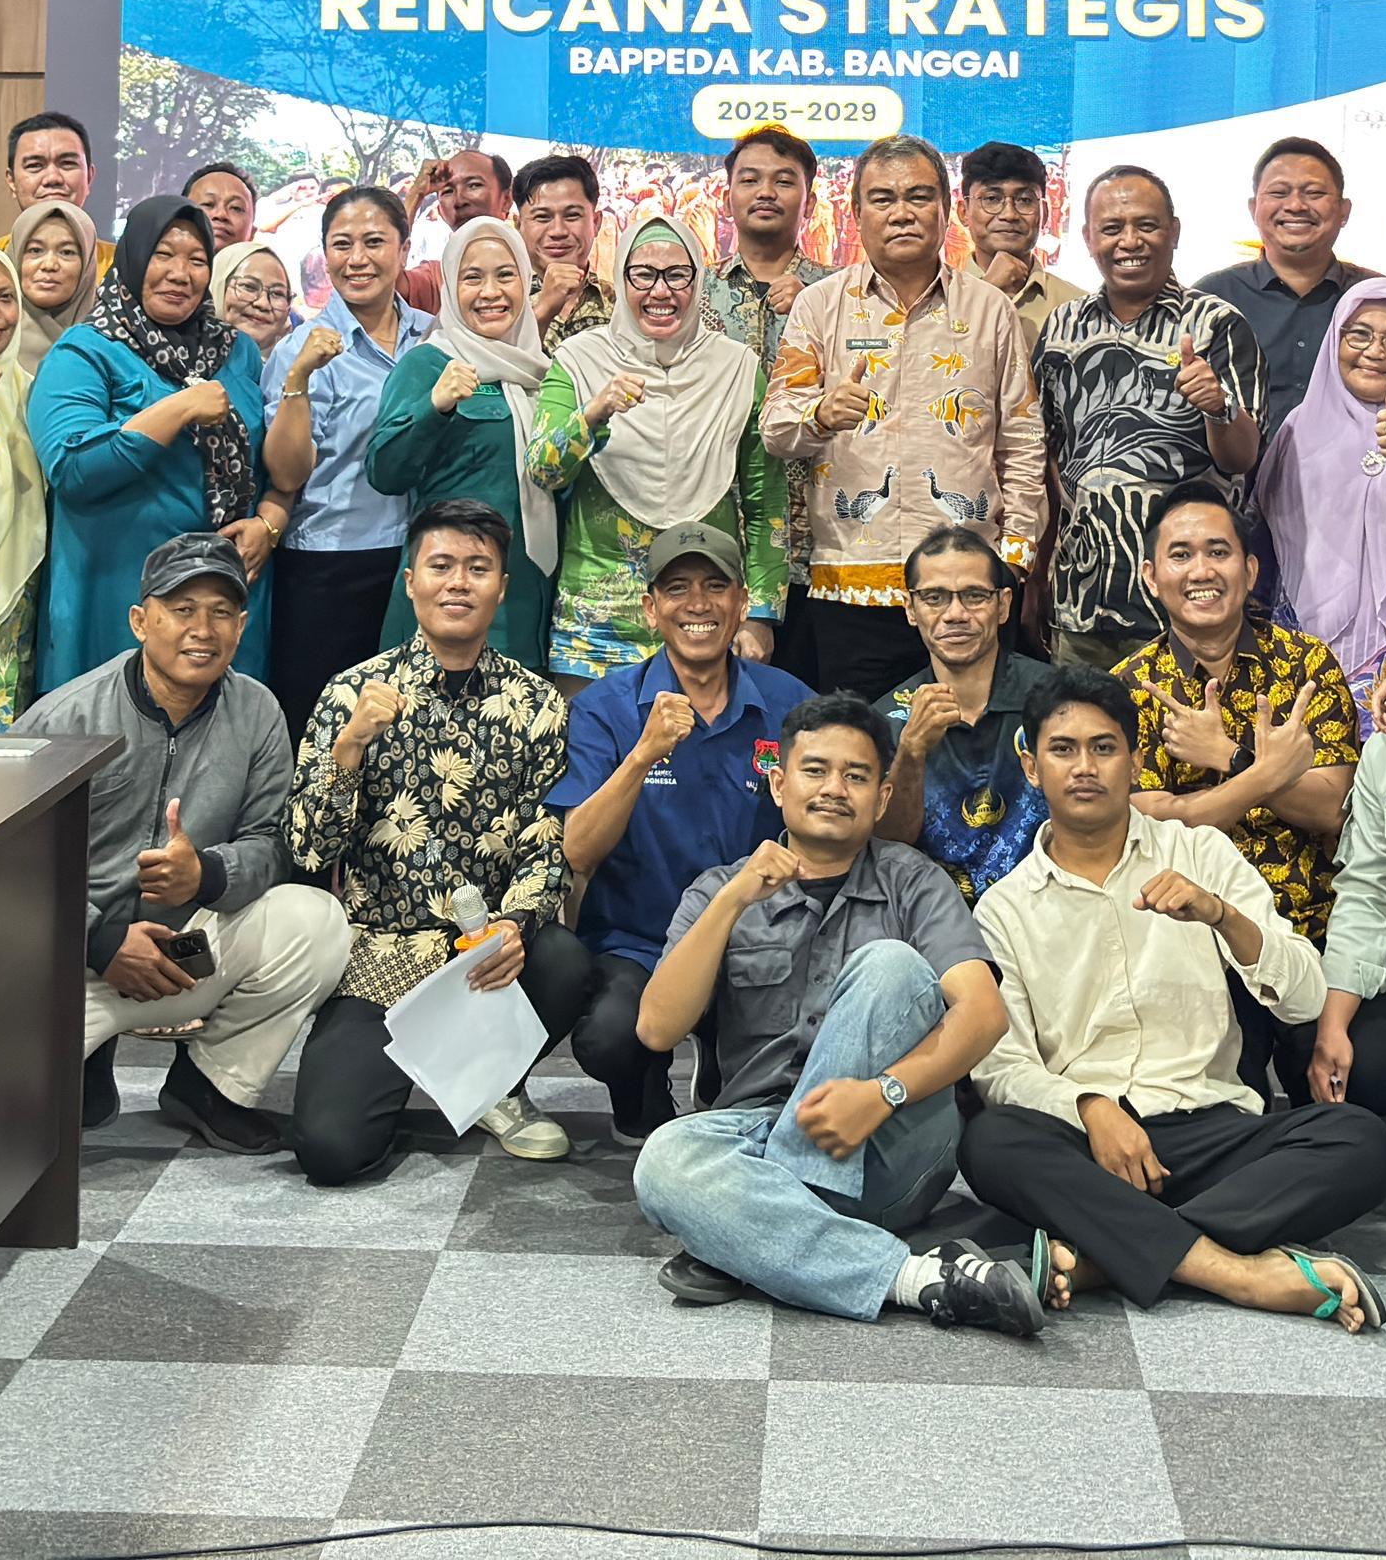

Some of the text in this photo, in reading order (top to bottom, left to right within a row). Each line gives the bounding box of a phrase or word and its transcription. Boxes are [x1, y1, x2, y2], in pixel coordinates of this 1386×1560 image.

[568, 45, 1020, 79] BAPPEDA KAB. BANGGAI
